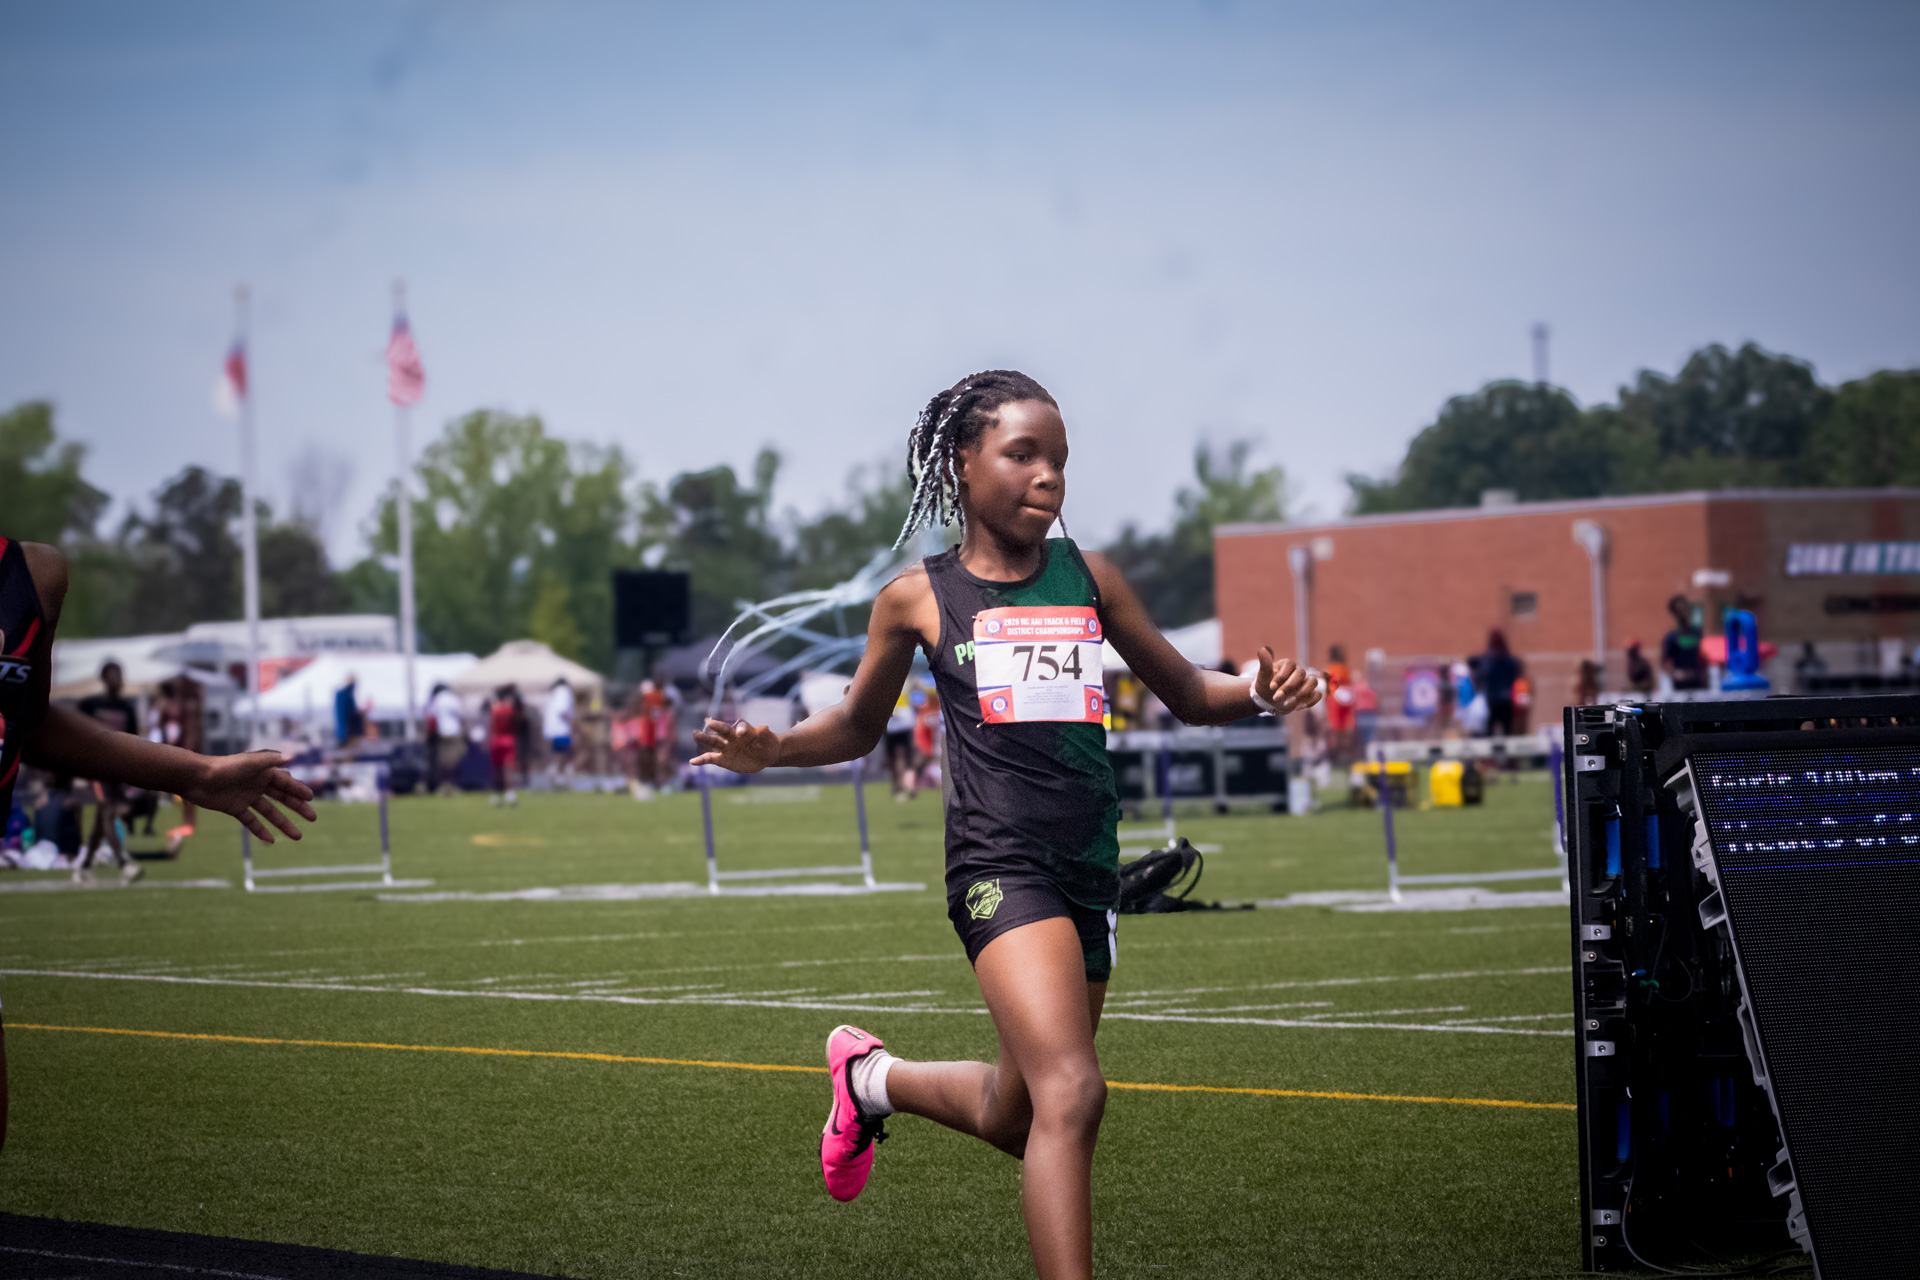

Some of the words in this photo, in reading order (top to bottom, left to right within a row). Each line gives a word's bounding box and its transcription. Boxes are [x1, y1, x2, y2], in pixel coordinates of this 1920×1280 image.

[1031, 617, 1043, 625] AAU
[1044, 617, 1063, 625] TRACK
[1070, 617, 1086, 625] FIELD
[1007, 627, 1034, 635] DISTRICT
[1035, 627, 1084, 635] CHAMPIONSHIPS
[1012, 644, 1083, 681] 754
